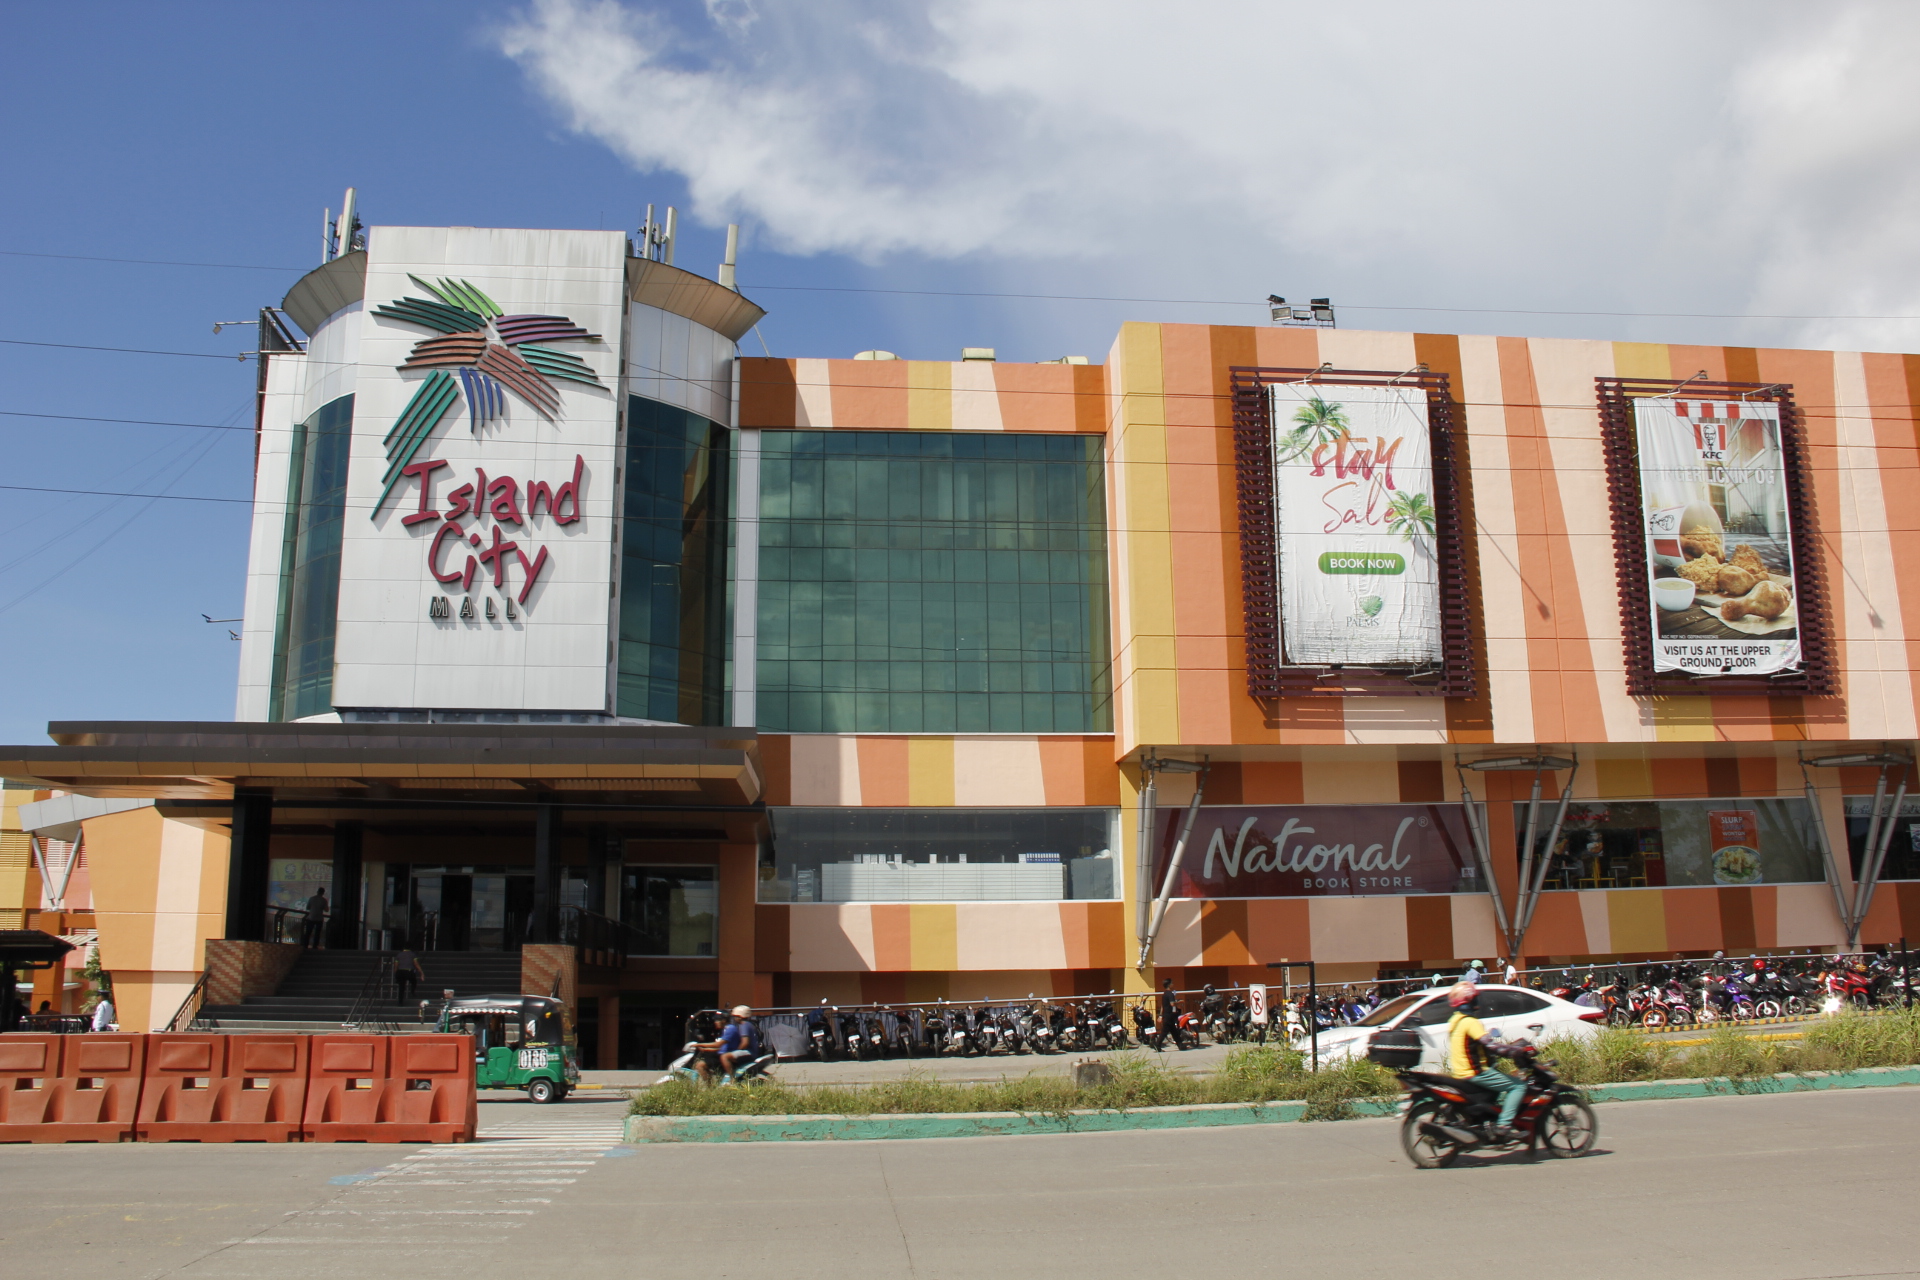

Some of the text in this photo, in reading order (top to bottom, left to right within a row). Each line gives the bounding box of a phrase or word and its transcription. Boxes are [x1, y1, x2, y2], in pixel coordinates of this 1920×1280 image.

[1702, 451, 1722, 459] KFC
[401, 454, 584, 526] Island
[1322, 471, 1400, 534] Sale
[428, 520, 548, 605] City
[1330, 558, 1396, 569] BOOK NOW
[429, 596, 517, 618] MALL
[1664, 646, 1771, 655] VISIT US AT THE UPPER
[1680, 658, 1757, 668] GROUND FLOOR
[1721, 816, 1744, 824] SLURP
[1203, 816, 1415, 879] National
[1303, 876, 1413, 889] BOOK STORE
